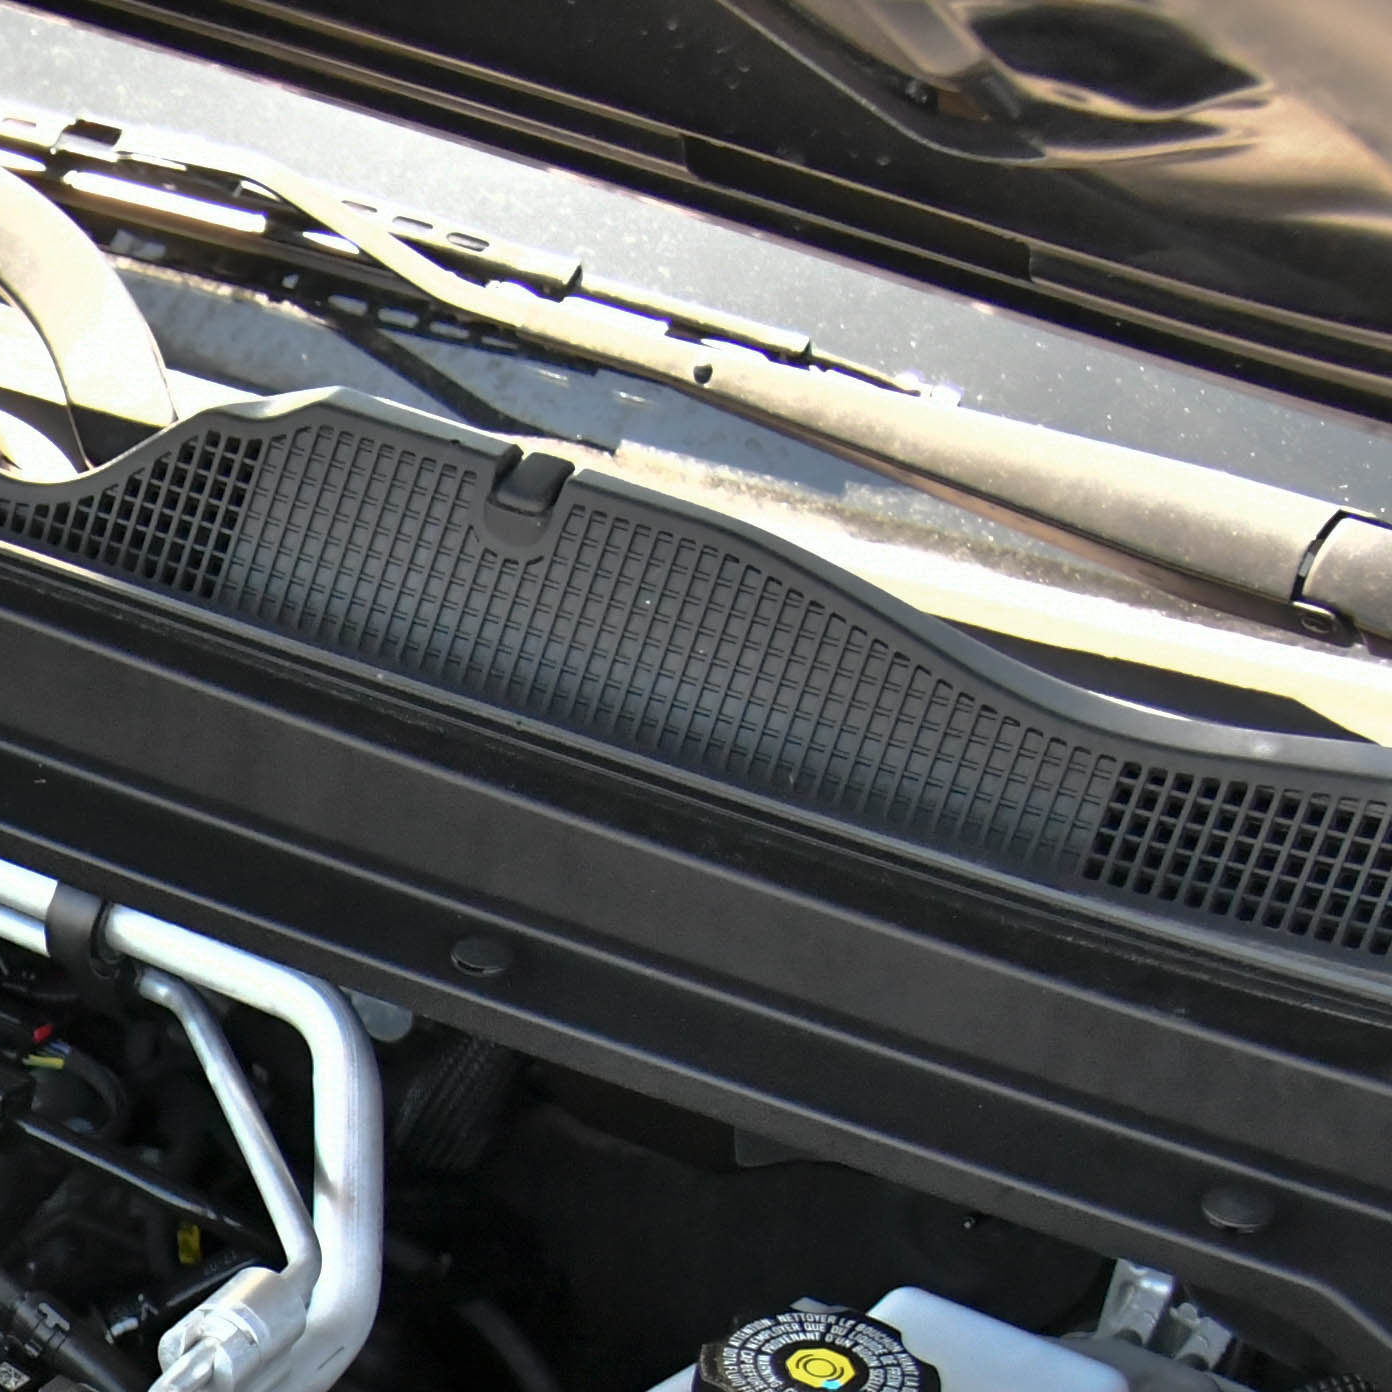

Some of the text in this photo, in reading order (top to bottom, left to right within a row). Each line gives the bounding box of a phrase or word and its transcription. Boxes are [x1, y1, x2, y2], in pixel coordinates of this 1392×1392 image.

[776, 1312, 837, 1324] NETTOYER
[804, 1322, 826, 1332] QUE
[830, 1325, 849, 1336] DU
